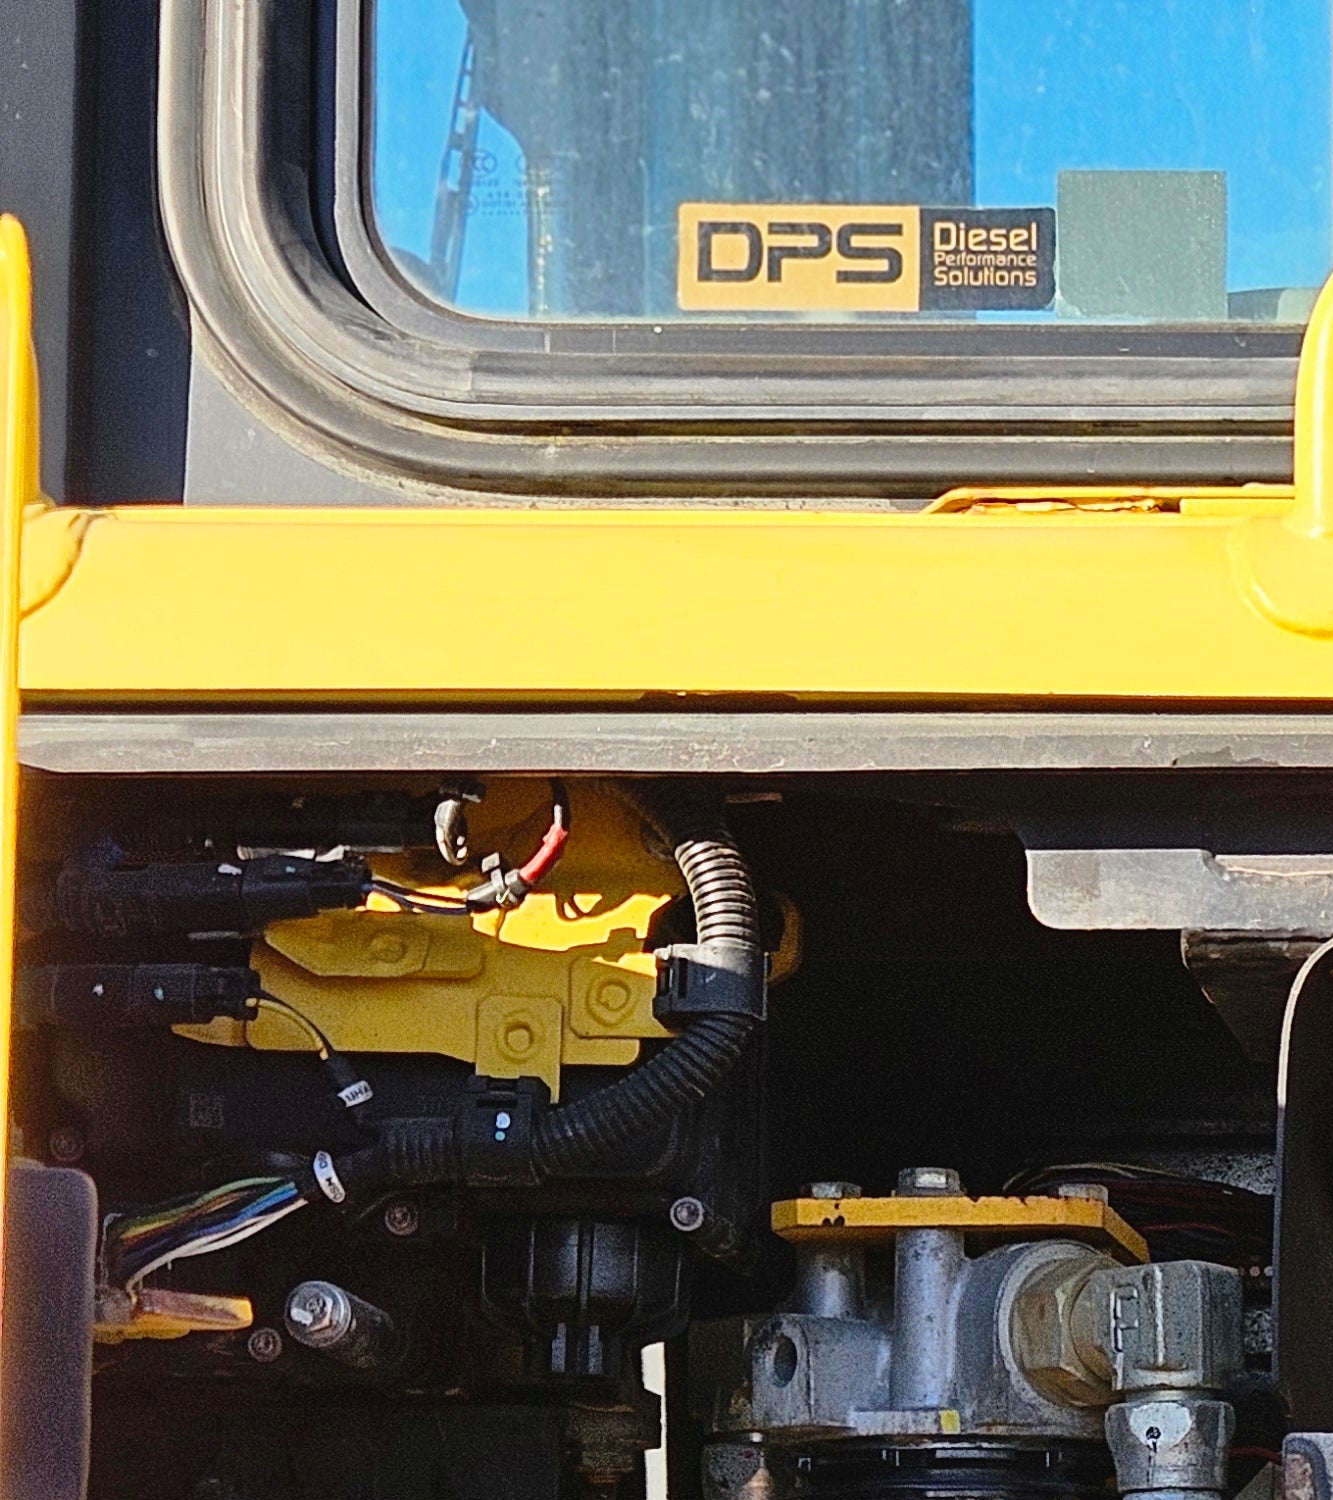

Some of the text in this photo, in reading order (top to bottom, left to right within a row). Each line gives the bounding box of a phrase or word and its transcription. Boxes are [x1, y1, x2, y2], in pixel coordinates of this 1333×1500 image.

[933, 222, 1038, 252] Diesel
[697, 221, 904, 284] DPS
[933, 251, 1038, 267] Performance
[933, 266, 1038, 288] Solutions
